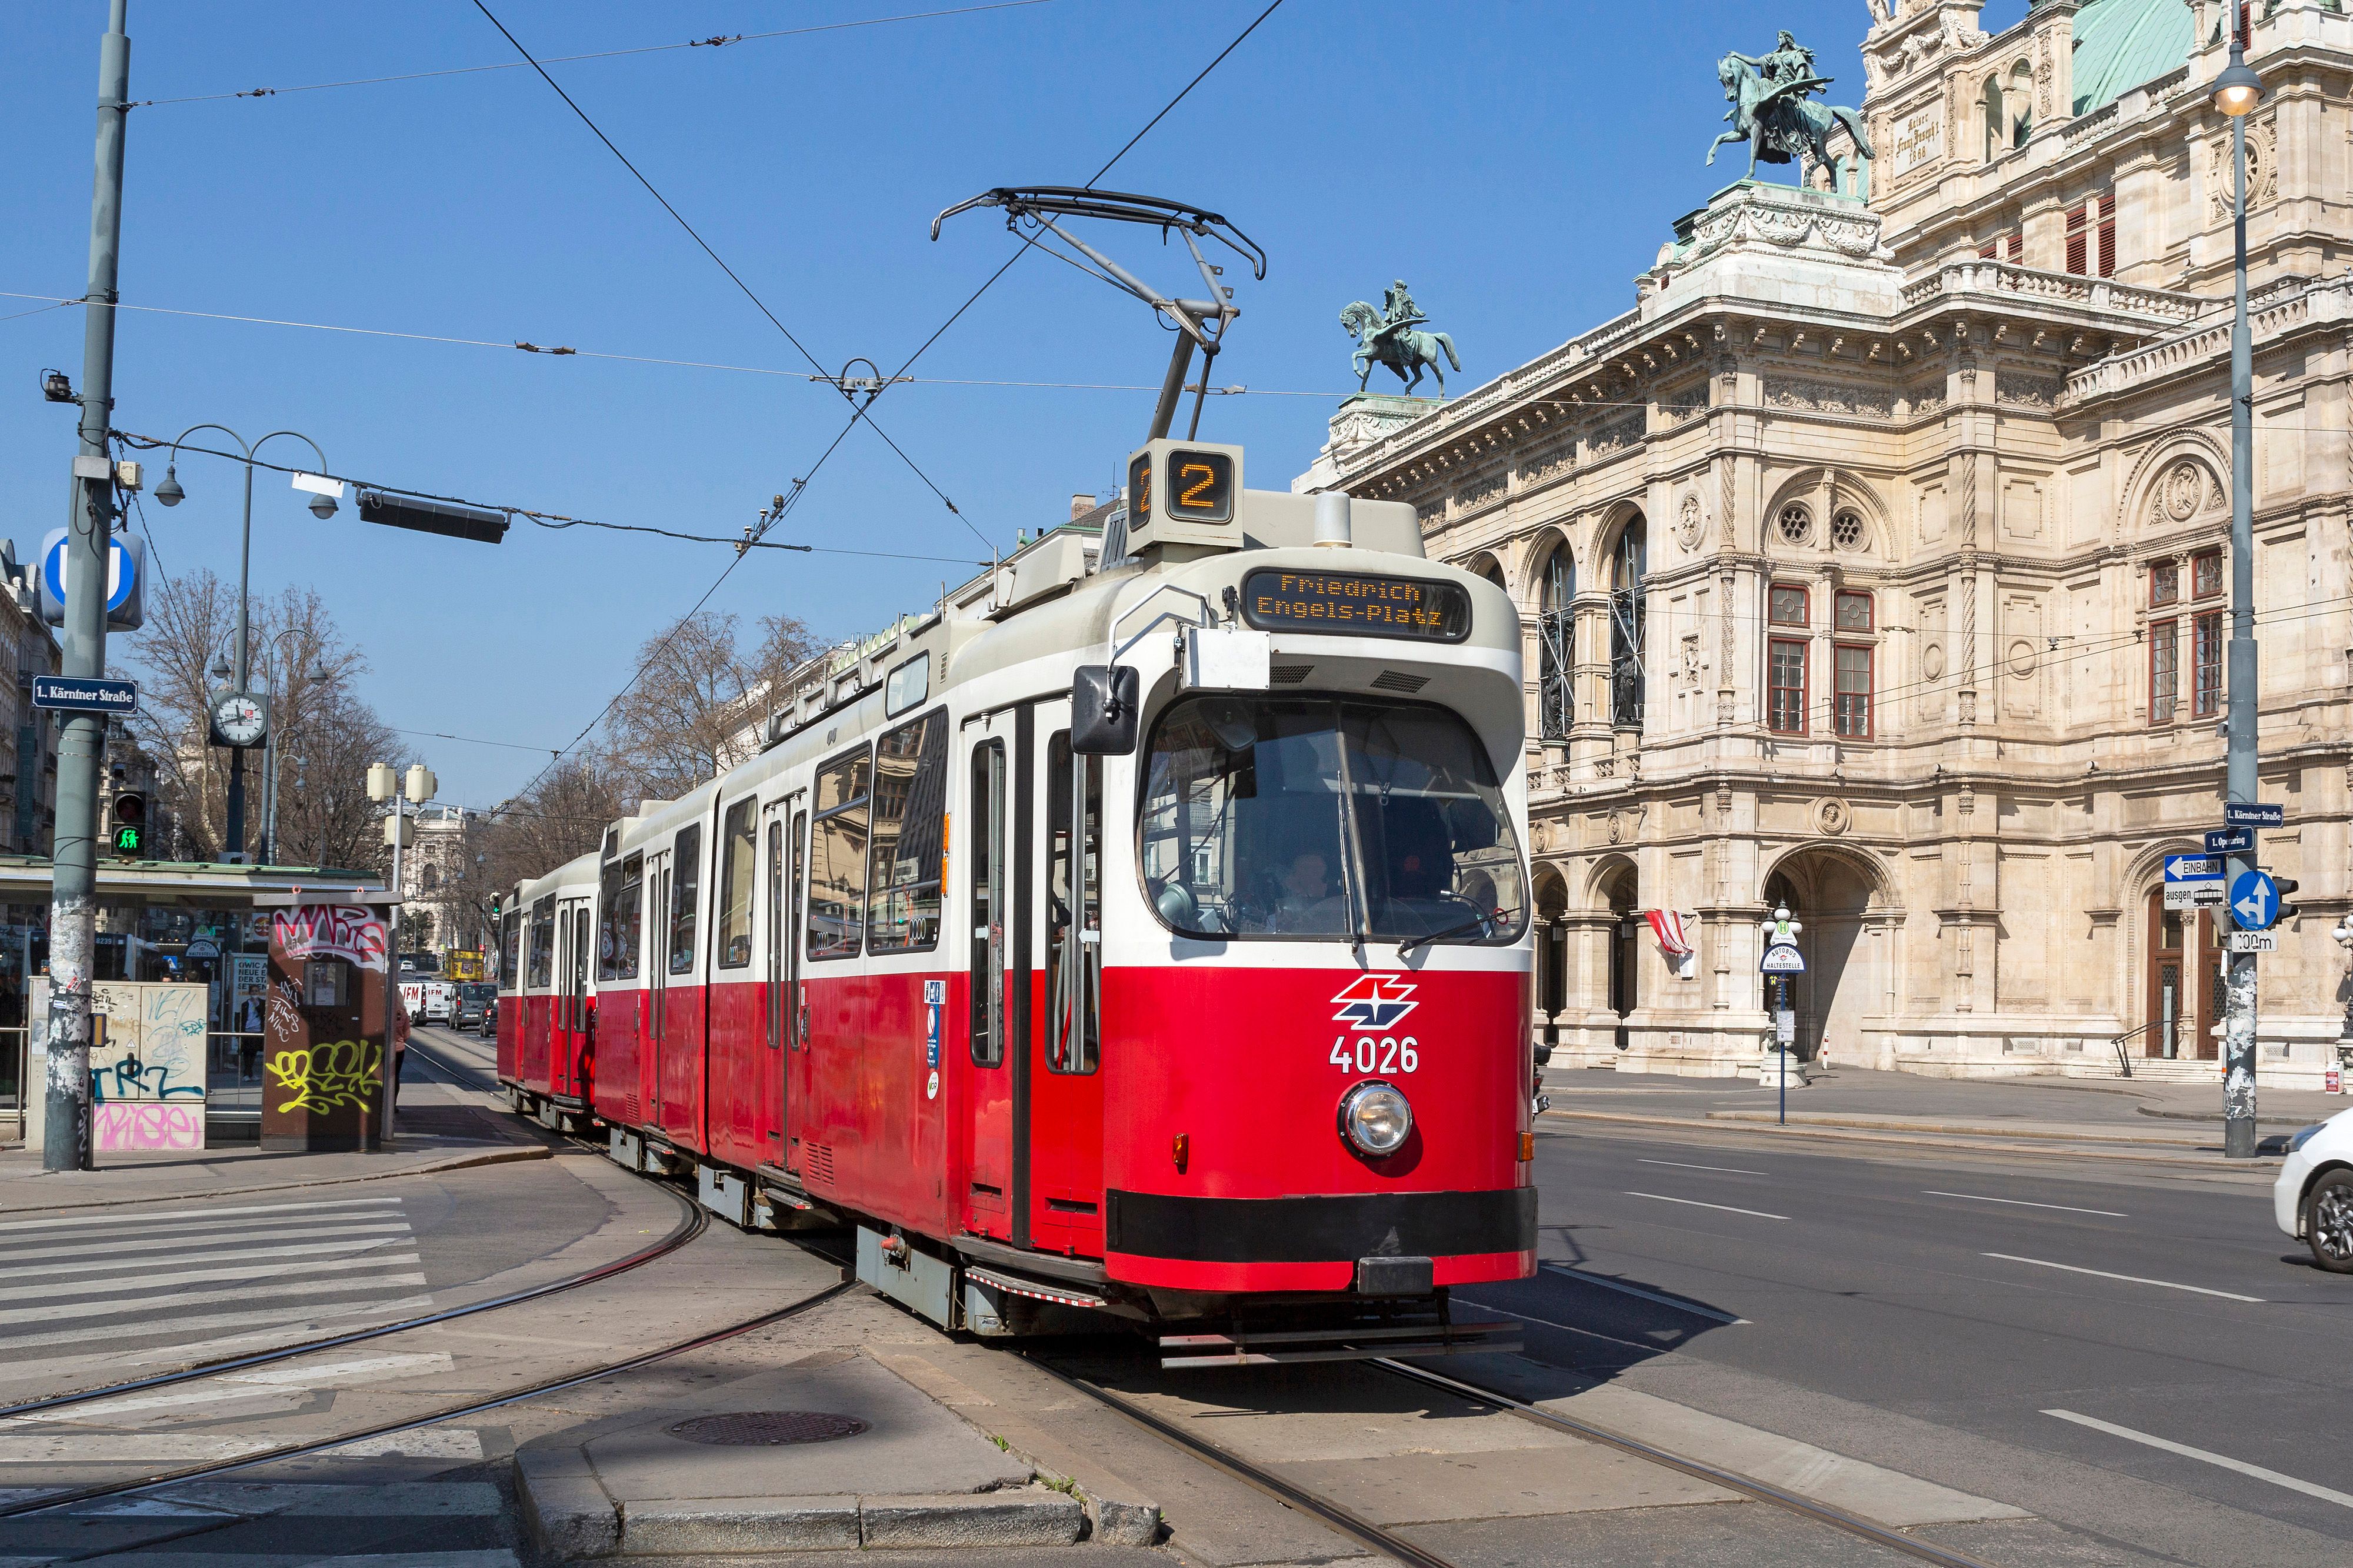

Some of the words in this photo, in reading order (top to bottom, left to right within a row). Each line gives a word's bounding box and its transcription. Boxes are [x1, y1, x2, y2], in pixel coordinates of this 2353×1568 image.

[1909, 146, 1925, 165] 1868
[1181, 463, 1214, 508] 2
[1281, 575, 1420, 600] Friedrich
[1258, 596, 1442, 626] Engels-Platz
[49, 686, 98, 700] Kärntner
[99, 689, 133, 703] Straße
[2234, 809, 2261, 820] Kärntner
[2262, 810, 2281, 821] Straße
[2218, 835, 2245, 848] Opernring
[2183, 861, 2218, 873] EINBAHN
[2166, 889, 2193, 903] ausgen.
[1772, 948, 1797, 958] AUTOBUS
[404, 987, 419, 1000] IFM
[1329, 1035, 1418, 1074] 4026
